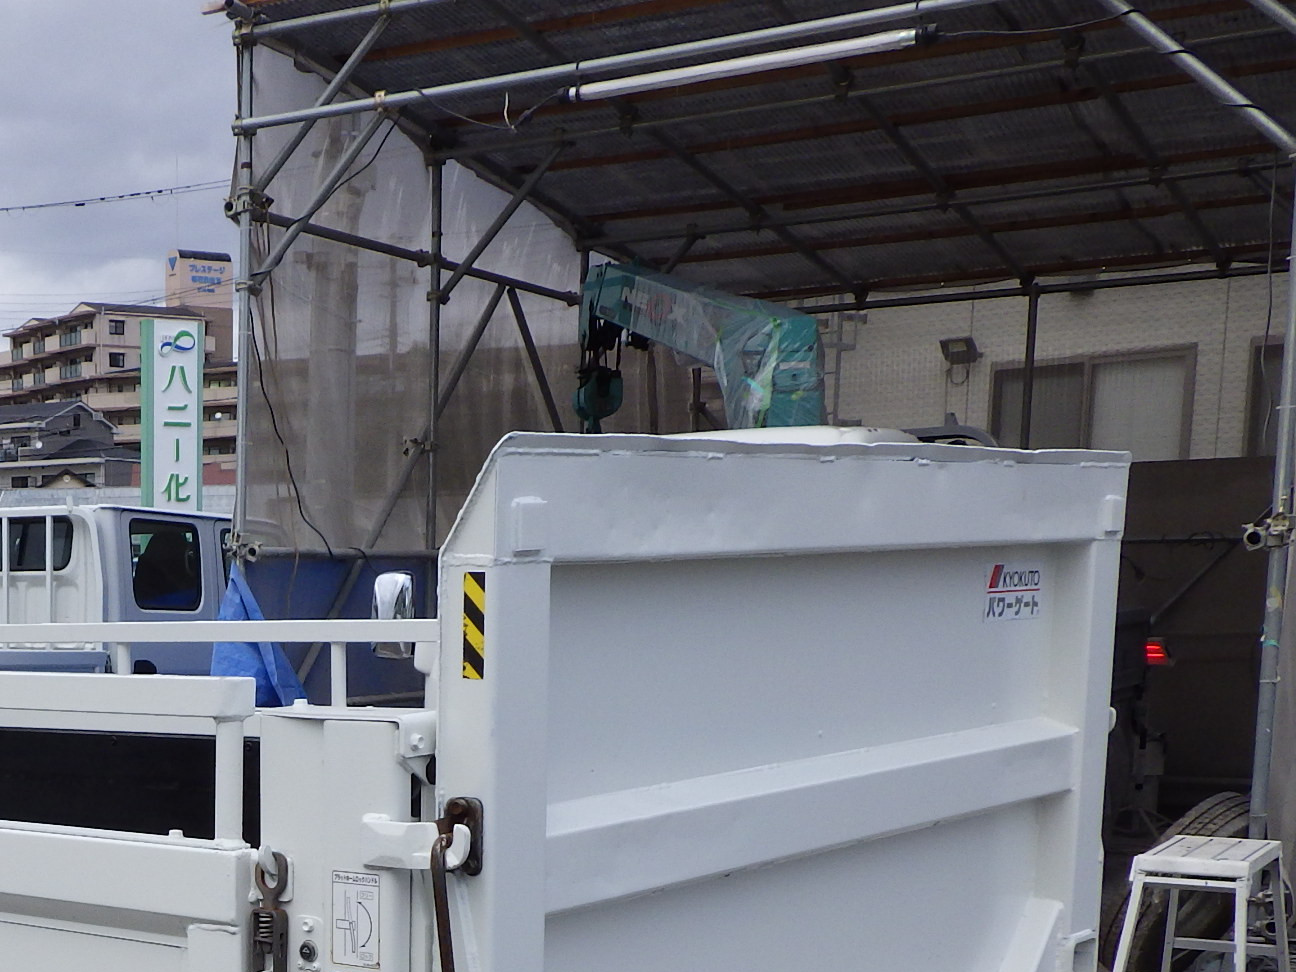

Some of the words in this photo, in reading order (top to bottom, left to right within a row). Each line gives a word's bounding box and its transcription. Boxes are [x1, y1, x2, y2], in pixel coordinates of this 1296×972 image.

[1003, 570, 1040, 588] KYOKUTO
[986, 594, 1039, 618] パワーゲート
